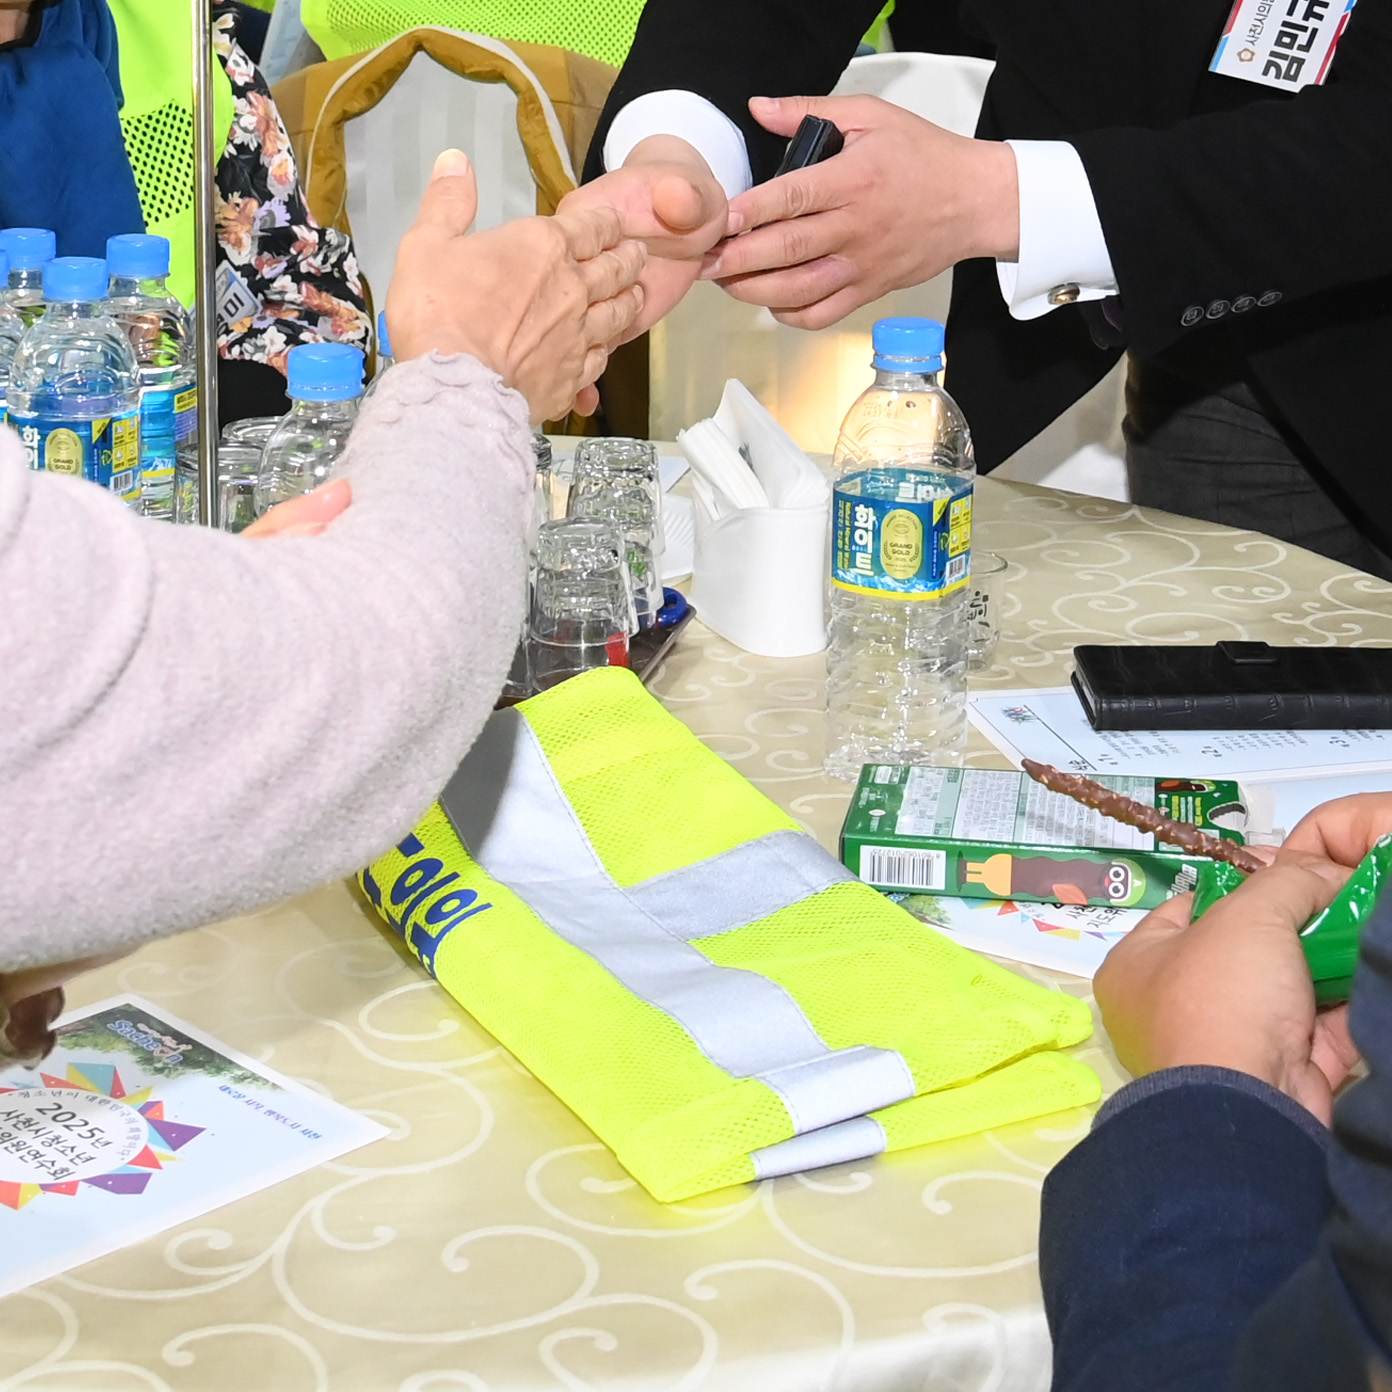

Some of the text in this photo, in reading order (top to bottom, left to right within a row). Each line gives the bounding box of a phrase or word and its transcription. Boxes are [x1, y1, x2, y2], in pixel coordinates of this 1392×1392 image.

[853, 504, 876, 576] 화이트
[889, 542, 913, 550] GRAND
[892, 549, 911, 557] GOLD
[0, 1109, 97, 1166] 사천시청소년
[35, 1102, 114, 1150] 2025년
